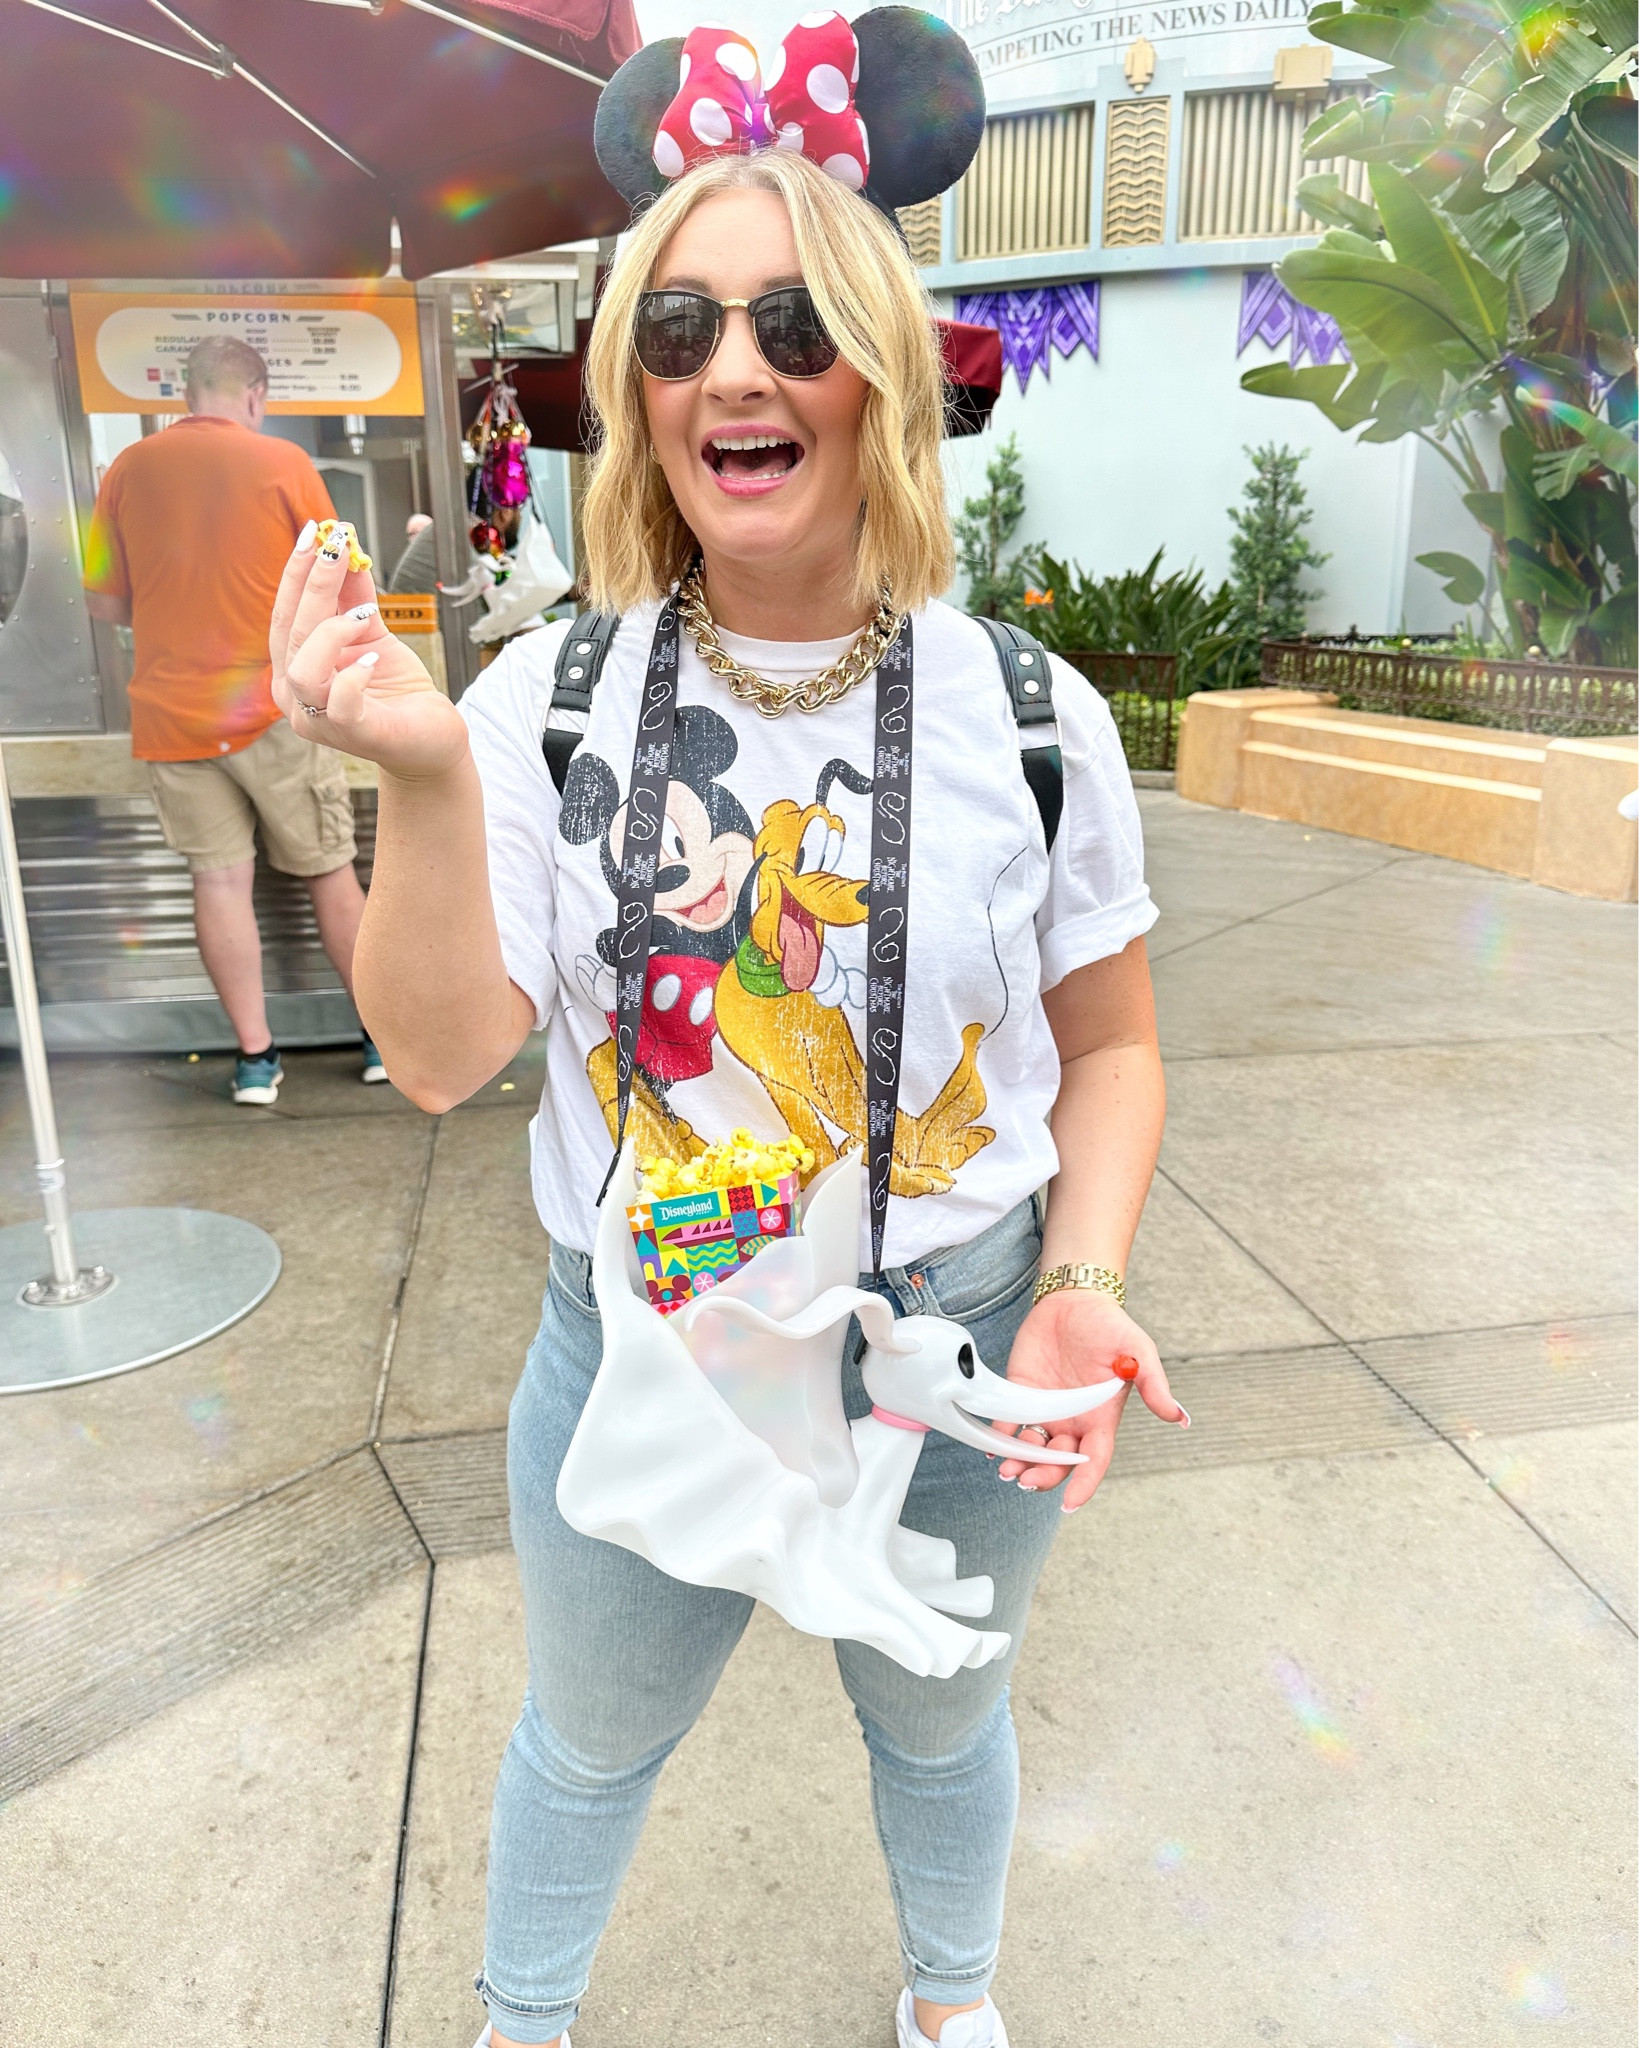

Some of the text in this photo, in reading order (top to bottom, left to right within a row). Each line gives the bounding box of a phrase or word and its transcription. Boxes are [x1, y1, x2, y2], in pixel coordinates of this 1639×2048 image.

[976, 0, 1313, 69] MPETING THE NEWS DAILY
[206, 312, 291, 323] POPCORN
[869, 978, 878, 1013] CHRISTMAS
[658, 1198, 714, 1221] Disneyland
